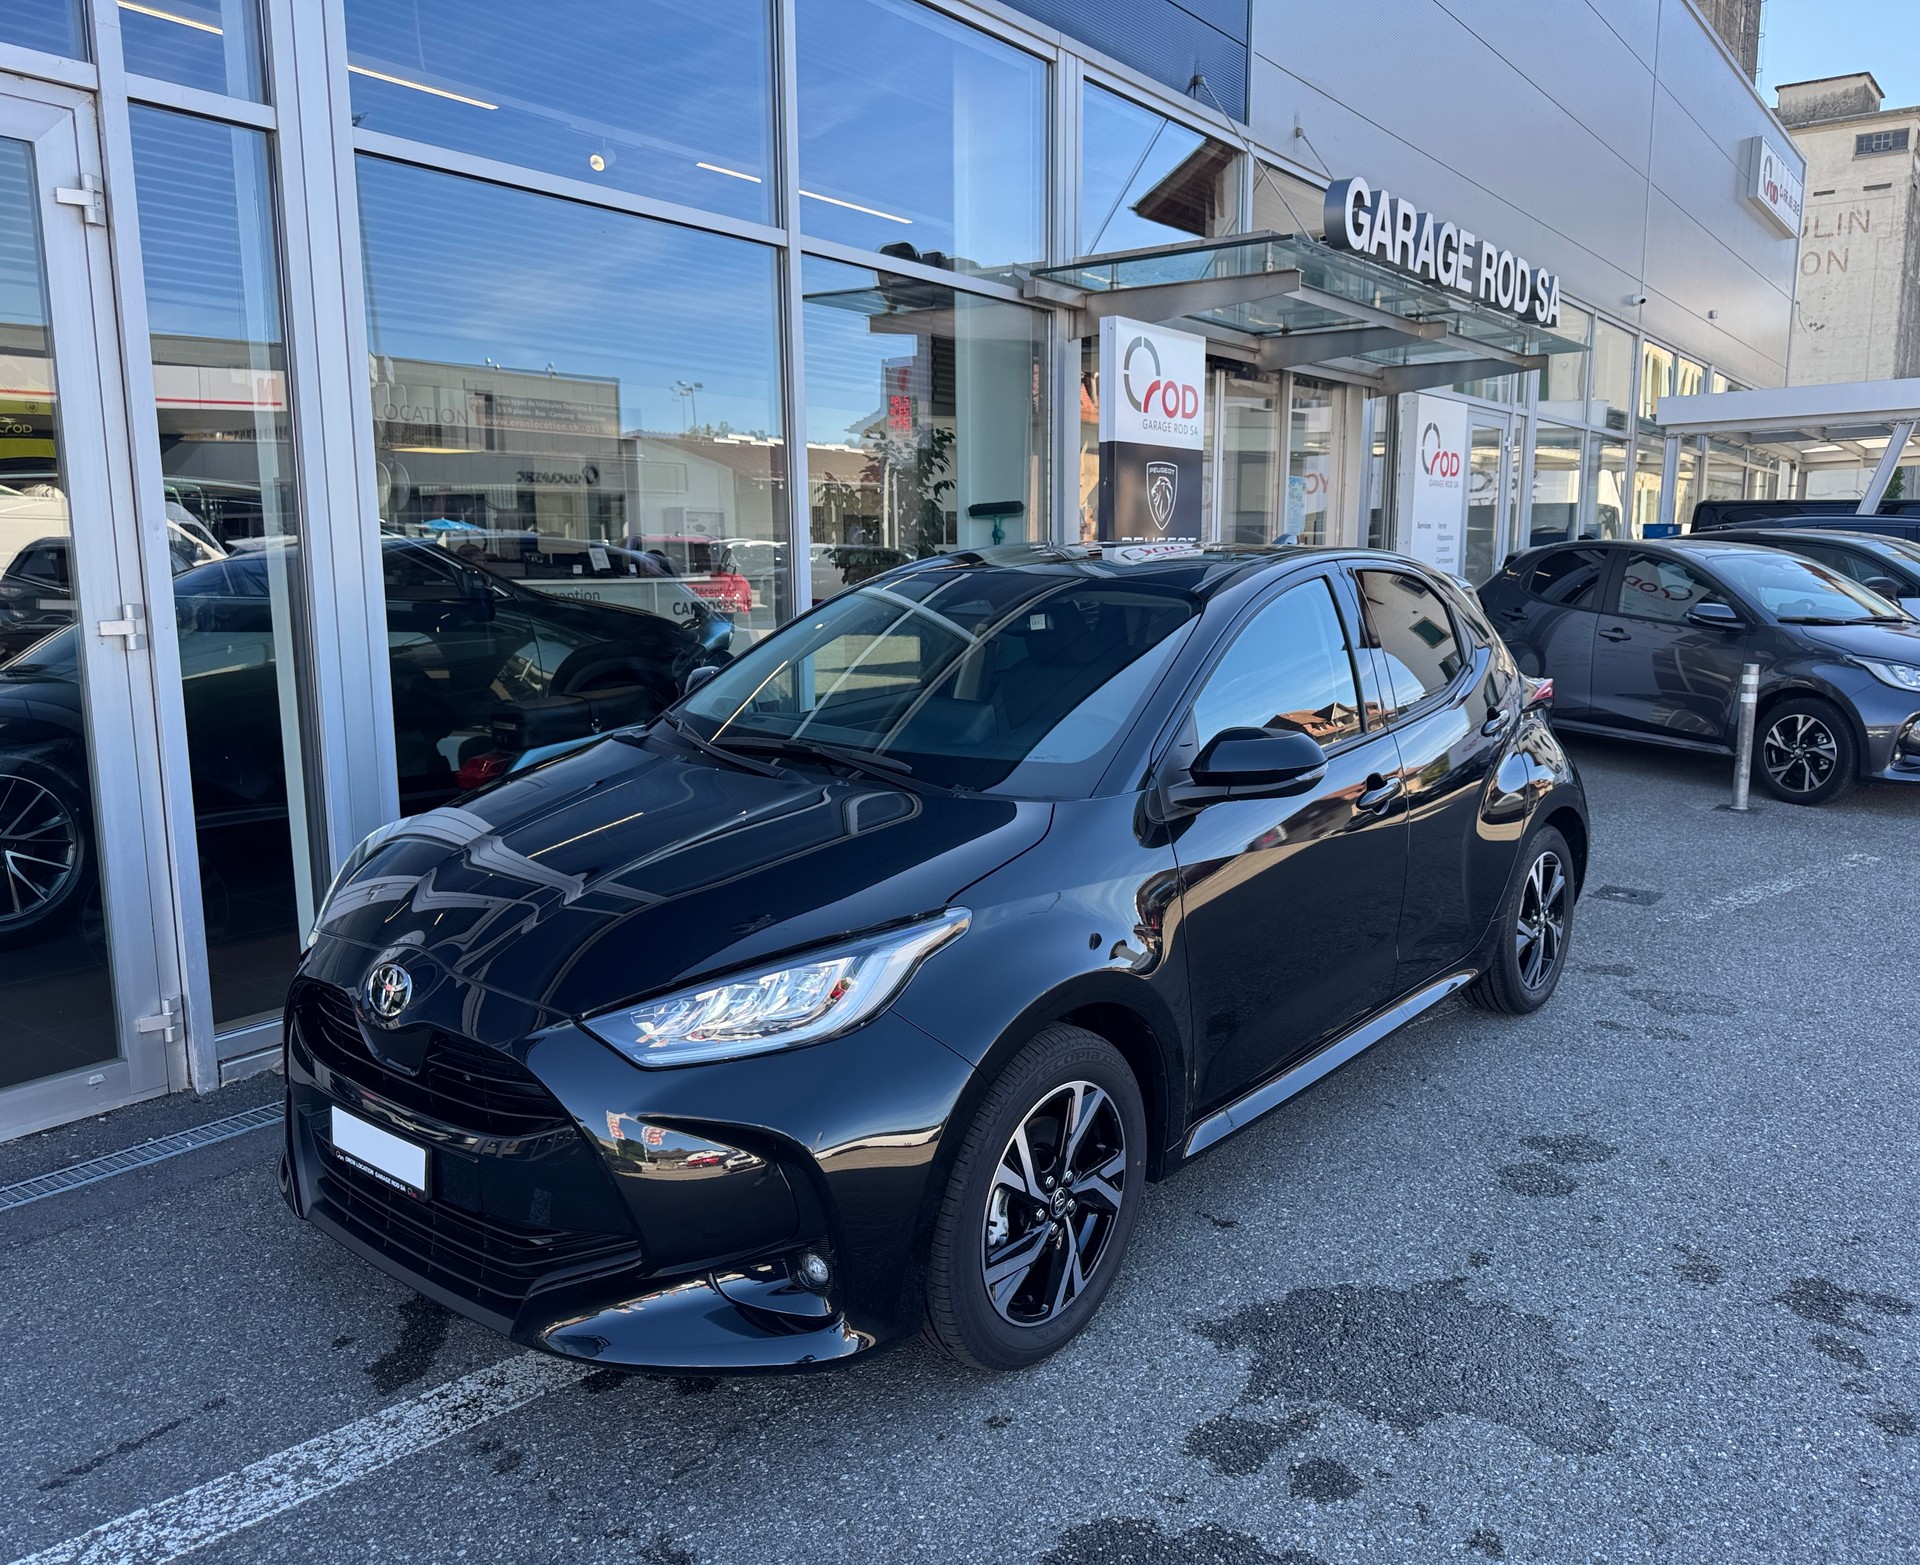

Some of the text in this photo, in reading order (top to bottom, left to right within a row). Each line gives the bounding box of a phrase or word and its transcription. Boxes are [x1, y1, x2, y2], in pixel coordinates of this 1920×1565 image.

[1344, 176, 1561, 328] GARAGE ROD SA
[373, 402, 468, 425] LOCATION
[1142, 418, 1198, 436] GARAGE ROD SA
[1149, 467, 1175, 475] PEUGEOT
